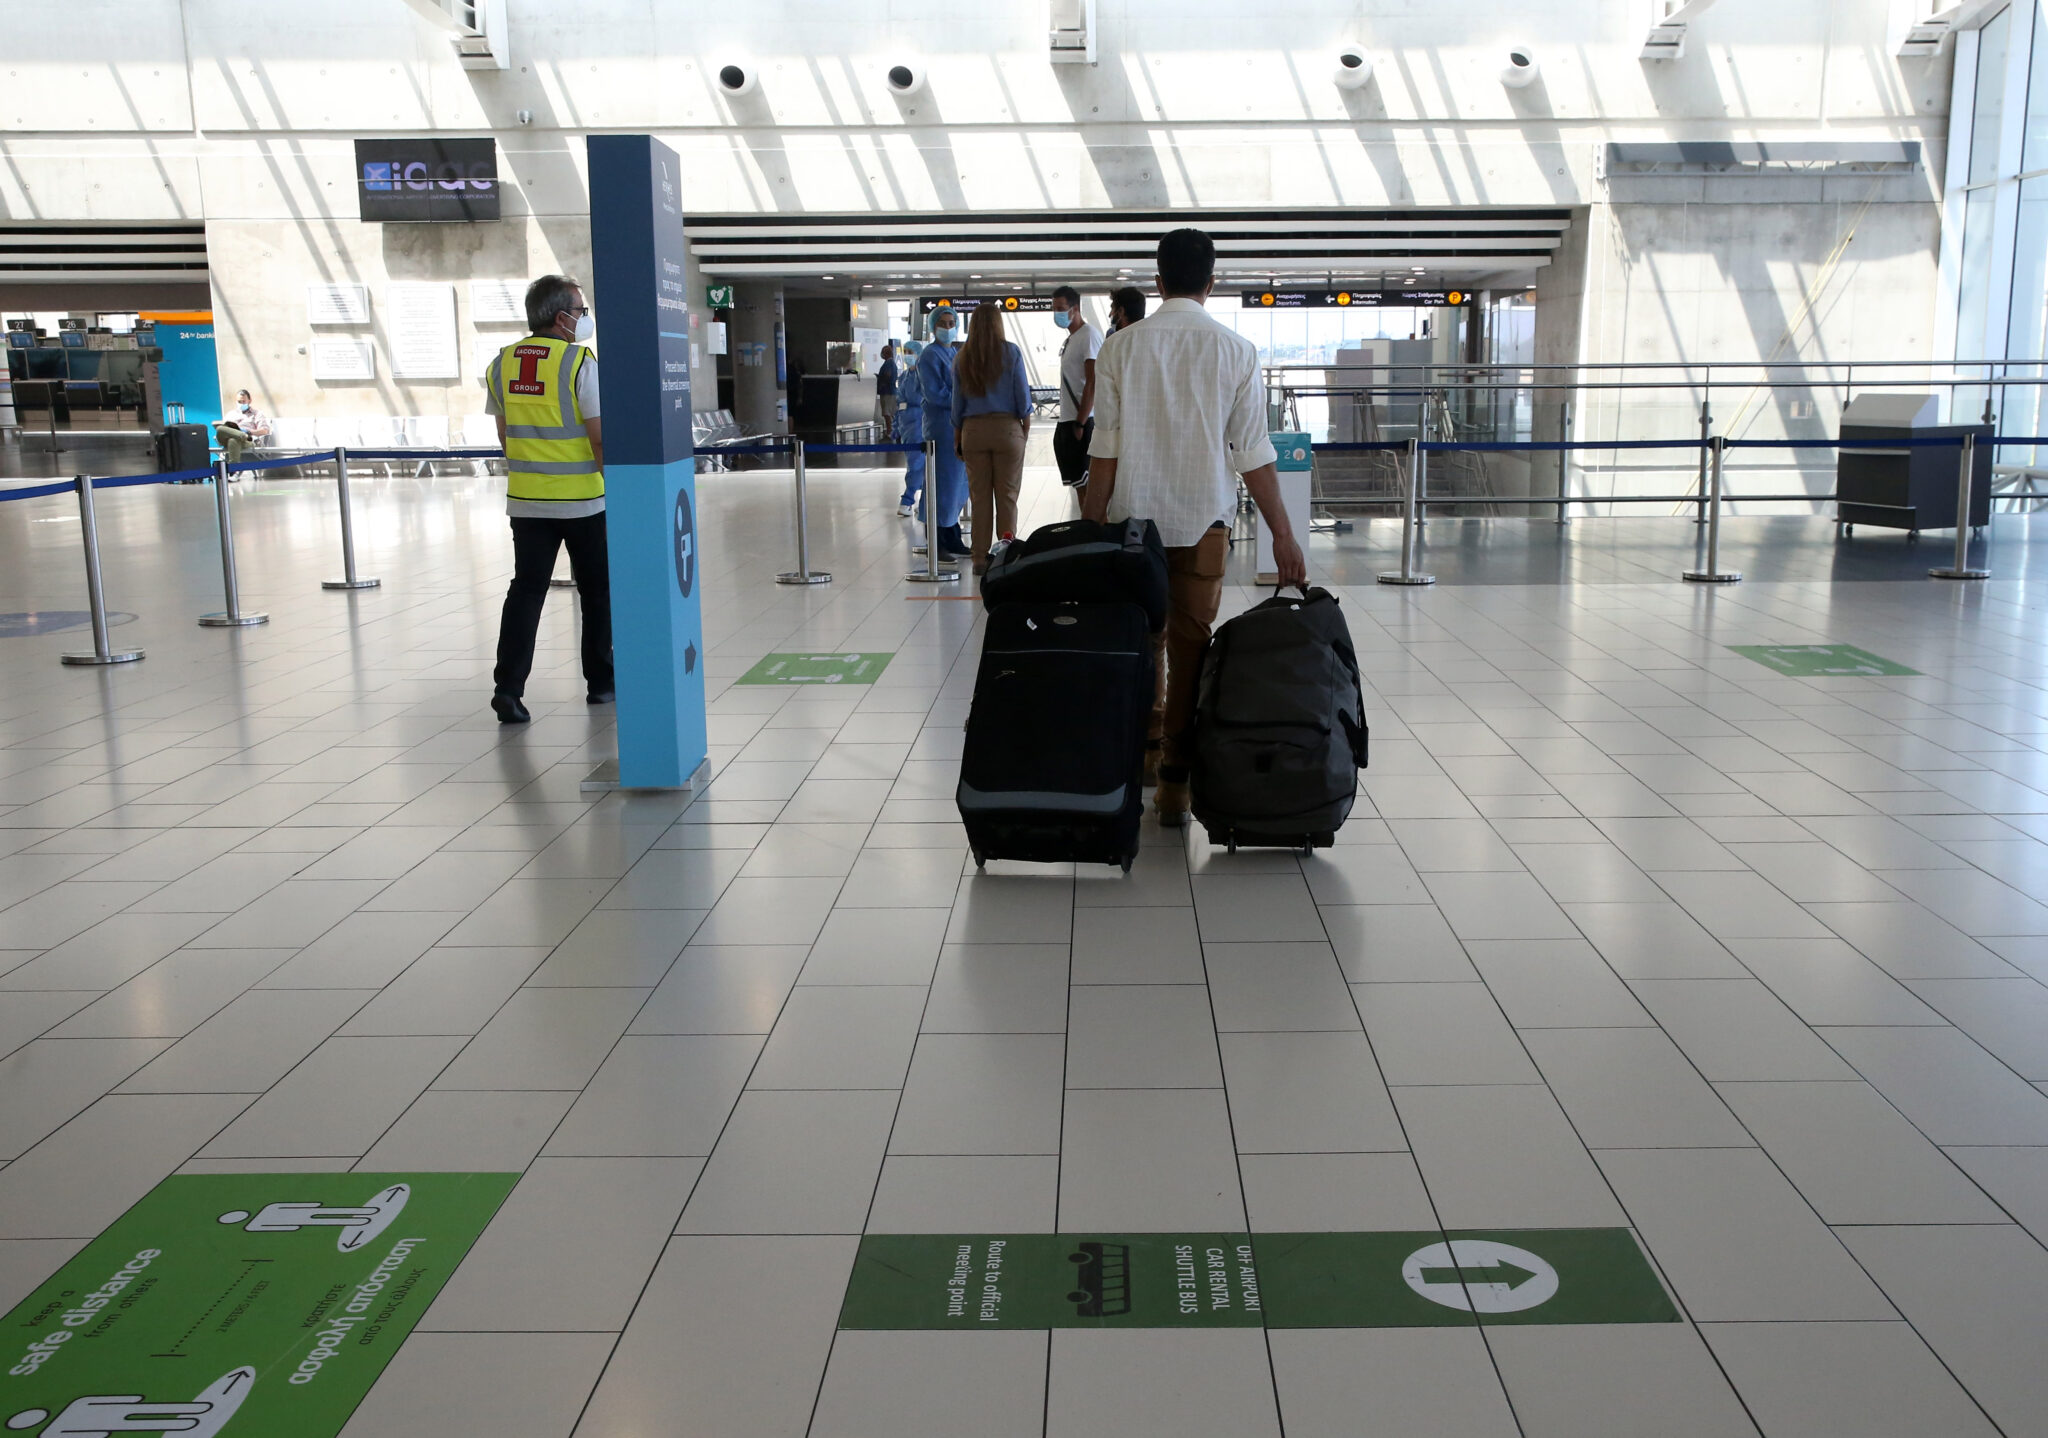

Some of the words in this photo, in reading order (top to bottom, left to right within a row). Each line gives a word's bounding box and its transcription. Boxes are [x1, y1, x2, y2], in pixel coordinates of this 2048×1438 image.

[66, 320, 76, 329] 26
[948, 1245, 973, 1286] meeting
[986, 1240, 1007, 1269] Route
[1175, 1245, 1196, 1289] SHUTTLE
[1206, 1248, 1225, 1268] CAR
[1236, 1245, 1254, 1264] OFF
[984, 1271, 1002, 1282] to
[1208, 1270, 1231, 1311] RENTAL
[9, 1329, 73, 1376] safe
[61, 1247, 162, 1327] distance
[21, 1300, 62, 1327] keep
[83, 1313, 120, 1338] from
[119, 1277, 158, 1308] others
[288, 1316, 366, 1384] ασφαλή
[340, 1237, 427, 1313] απόσταση
[301, 1282, 347, 1329] κρατήστε
[358, 1323, 382, 1346] από
[373, 1299, 402, 1324] τους
[389, 1267, 427, 1301] άλλους
[947, 1288, 968, 1317] point
[979, 1284, 1002, 1321] official
[1179, 1291, 1199, 1314] BUS
